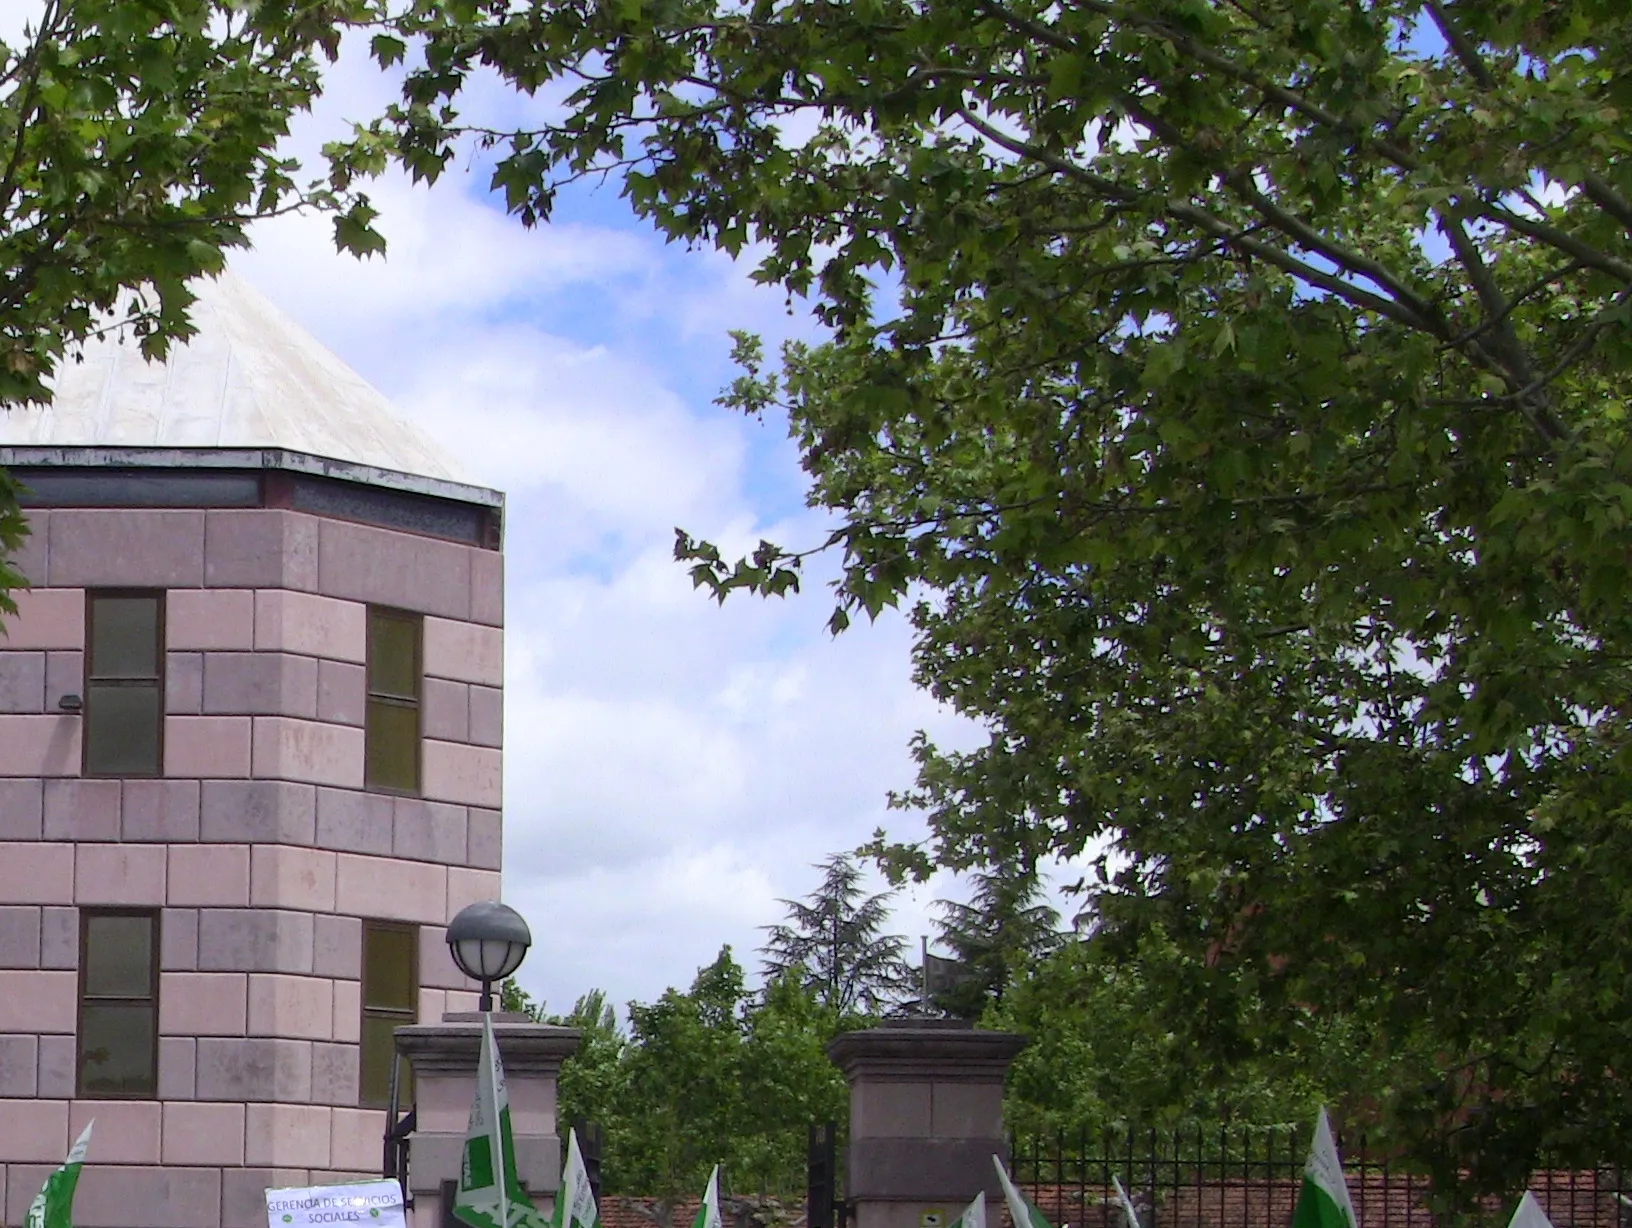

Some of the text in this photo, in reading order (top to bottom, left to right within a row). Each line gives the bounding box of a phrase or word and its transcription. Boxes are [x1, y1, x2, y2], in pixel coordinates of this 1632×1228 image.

[268, 1198, 321, 1212] GERENCIA
[324, 1197, 338, 1207] DE
[309, 1211, 360, 1224] SOCIALES
